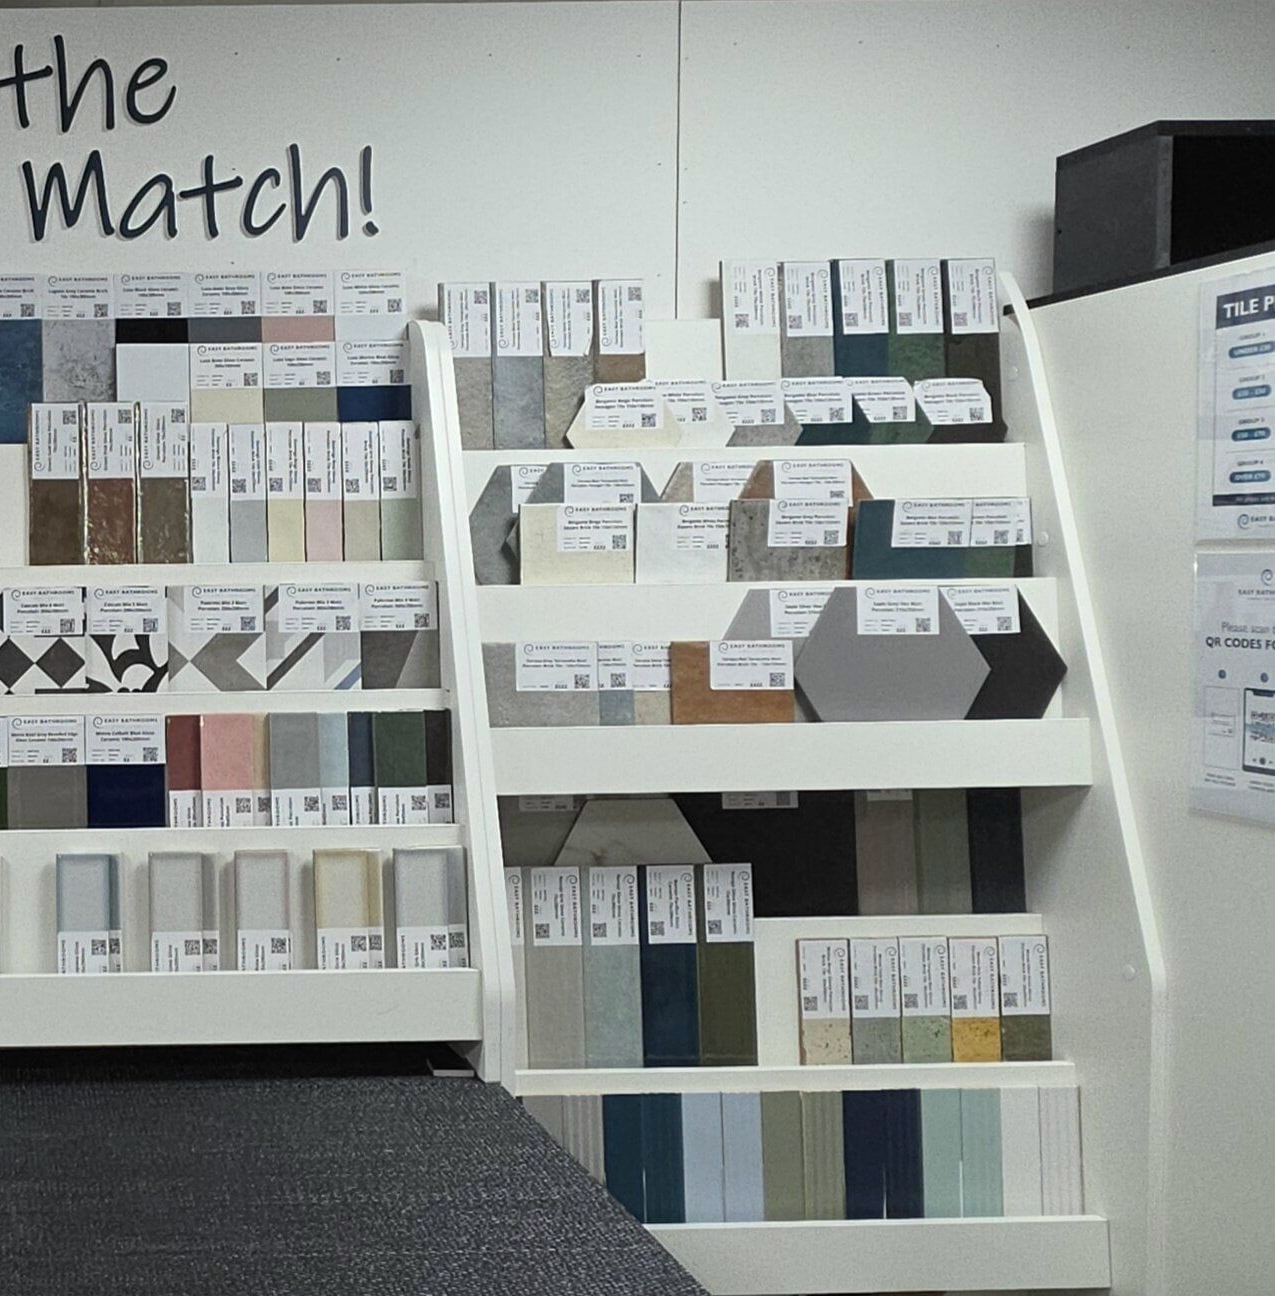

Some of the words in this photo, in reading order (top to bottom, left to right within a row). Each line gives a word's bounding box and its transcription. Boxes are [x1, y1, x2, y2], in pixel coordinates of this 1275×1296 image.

[21, 143, 381, 242] Match!
[1222, 298, 1260, 318] TILE
[1263, 295, 1275, 311] P
[1221, 620, 1248, 633] Please
[1205, 636, 1222, 649] QR
[1224, 637, 1263, 650] CODES
